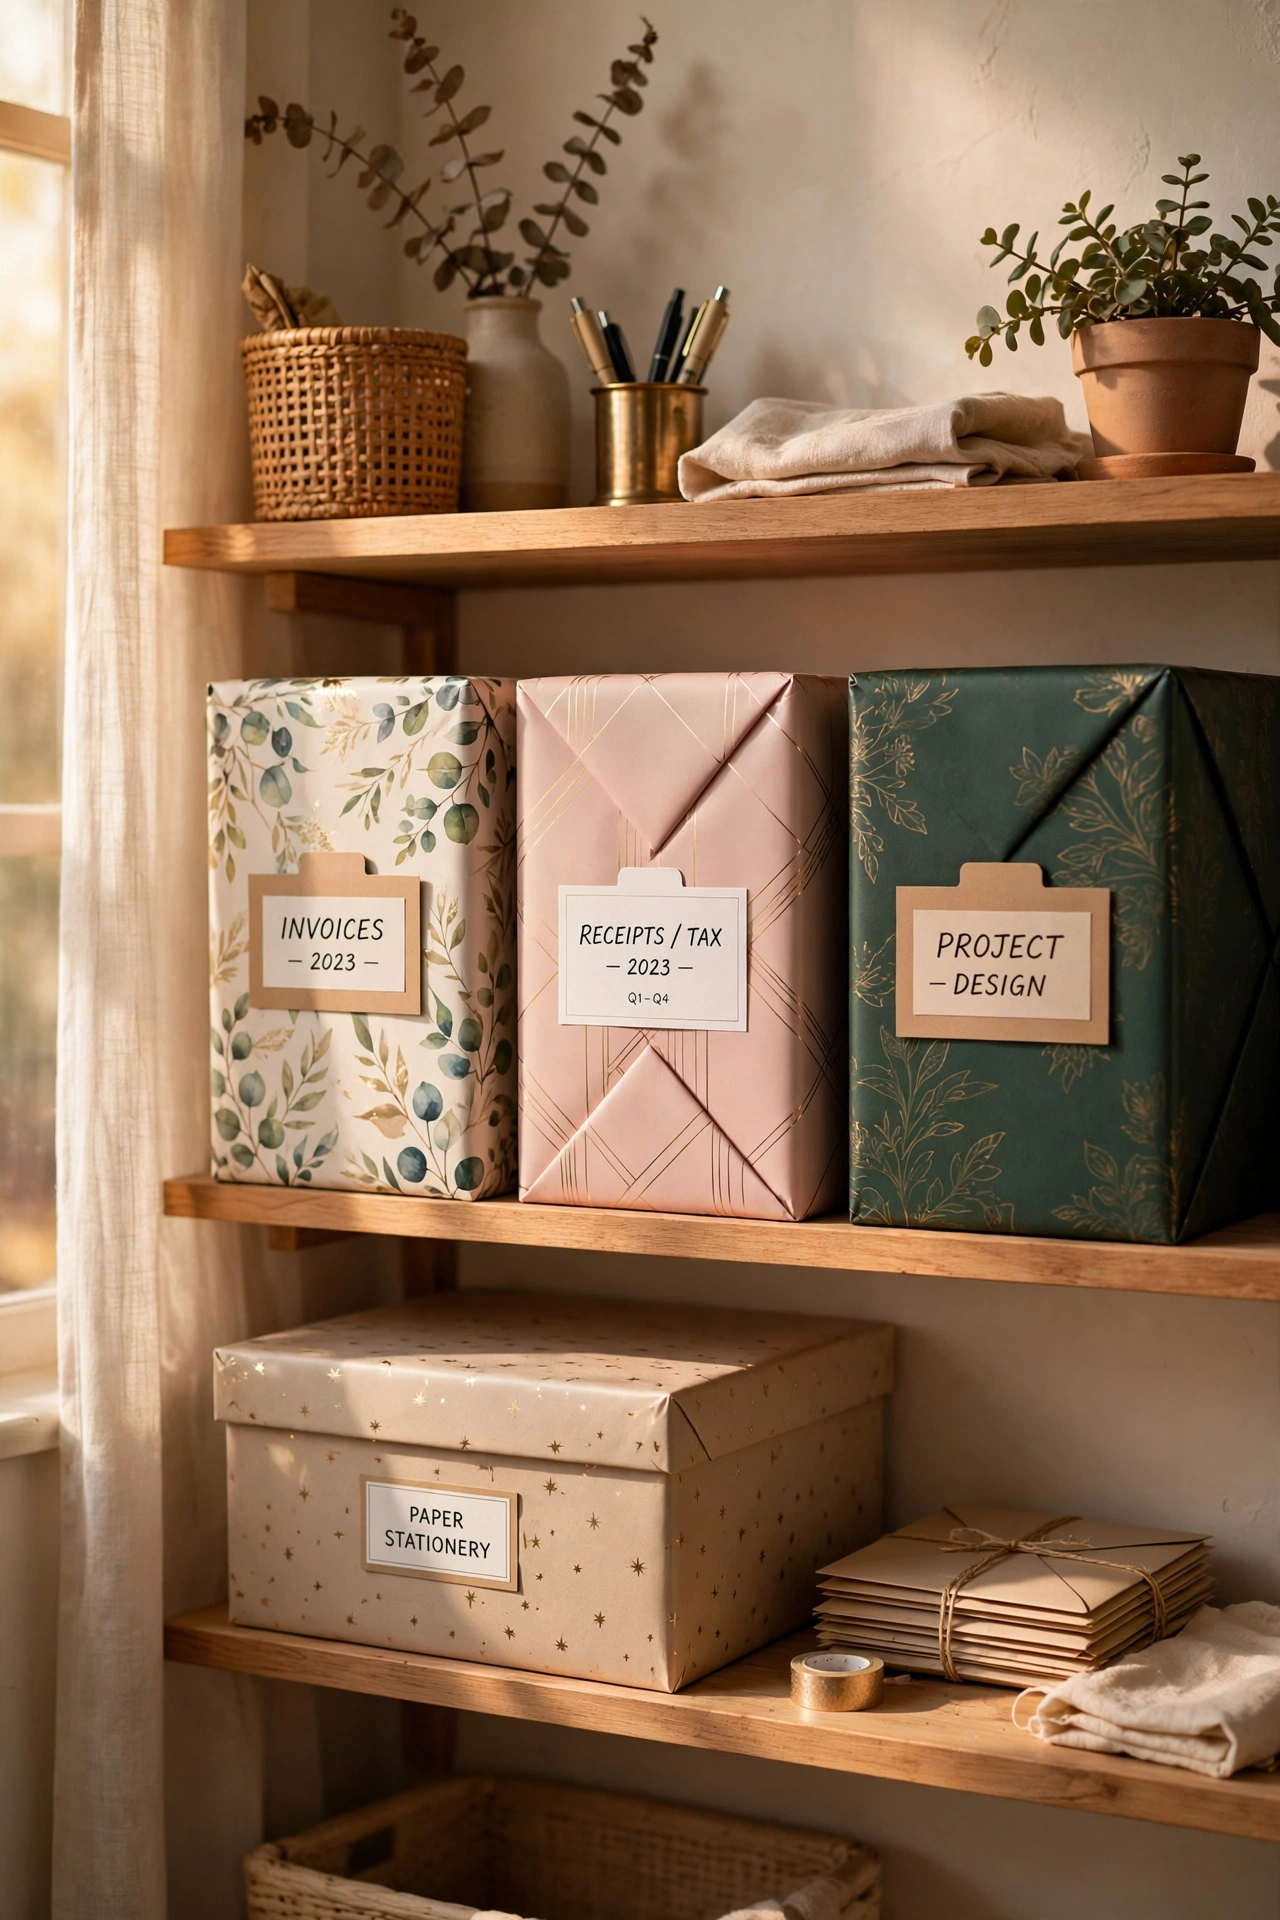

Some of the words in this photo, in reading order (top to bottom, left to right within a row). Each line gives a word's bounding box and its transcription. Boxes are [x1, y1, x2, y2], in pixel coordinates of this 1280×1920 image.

[281, 916, 384, 941] INVOICES
[579, 923, 665, 946] RECEIPTS
[686, 926, 723, 948] TAX
[936, 931, 1065, 960] PROJECT
[310, 951, 356, 972] 2023
[627, 957, 671, 977] 2023
[953, 972, 1047, 997] DESIGN
[410, 1506, 464, 1530] PAPER
[384, 1529, 491, 1559] STATIONERY
